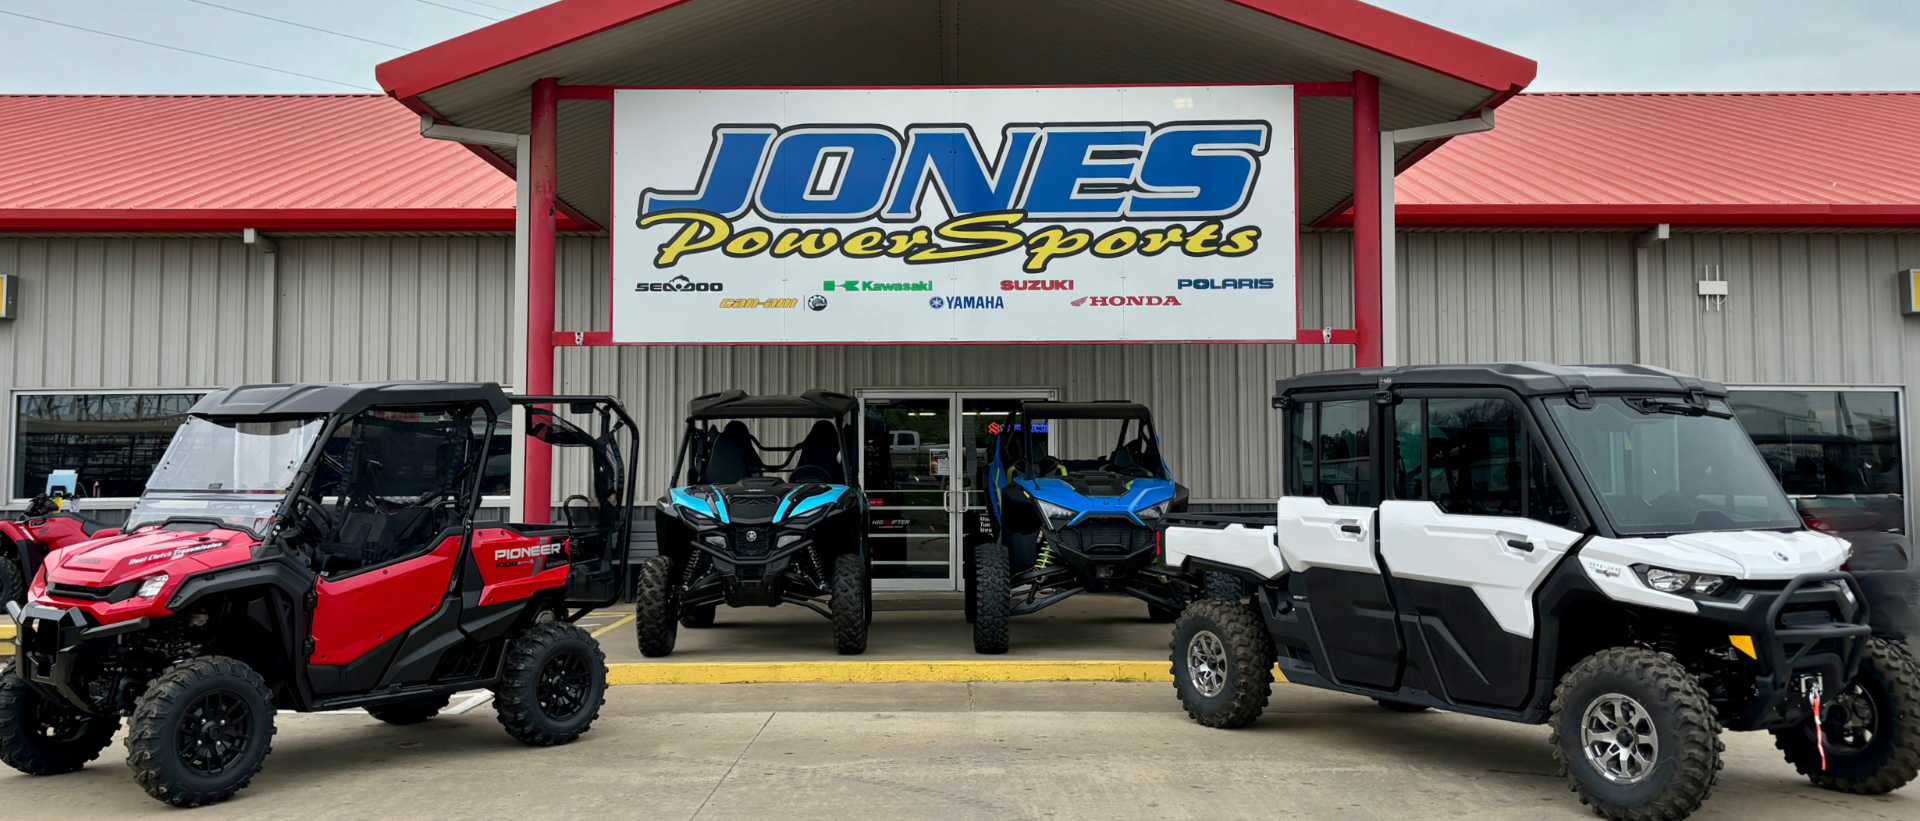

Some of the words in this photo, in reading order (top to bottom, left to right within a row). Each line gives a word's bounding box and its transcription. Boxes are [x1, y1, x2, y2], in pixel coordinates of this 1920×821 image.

[637, 121, 1271, 221] JONES
[640, 208, 1261, 273] PowerSports
[862, 280, 933, 291] Kawasaki
[1000, 279, 1074, 291] SUZUKI
[1177, 278, 1275, 290] POLARIS
[946, 296, 1004, 309] YAMAHA
[1089, 295, 1182, 307] HONDA
[128, 556, 147, 566] Dual
[148, 551, 172, 561] Clutch
[173, 542, 223, 556] Transmission
[494, 543, 561, 560] PIONEER
[495, 561, 518, 569] 1000
